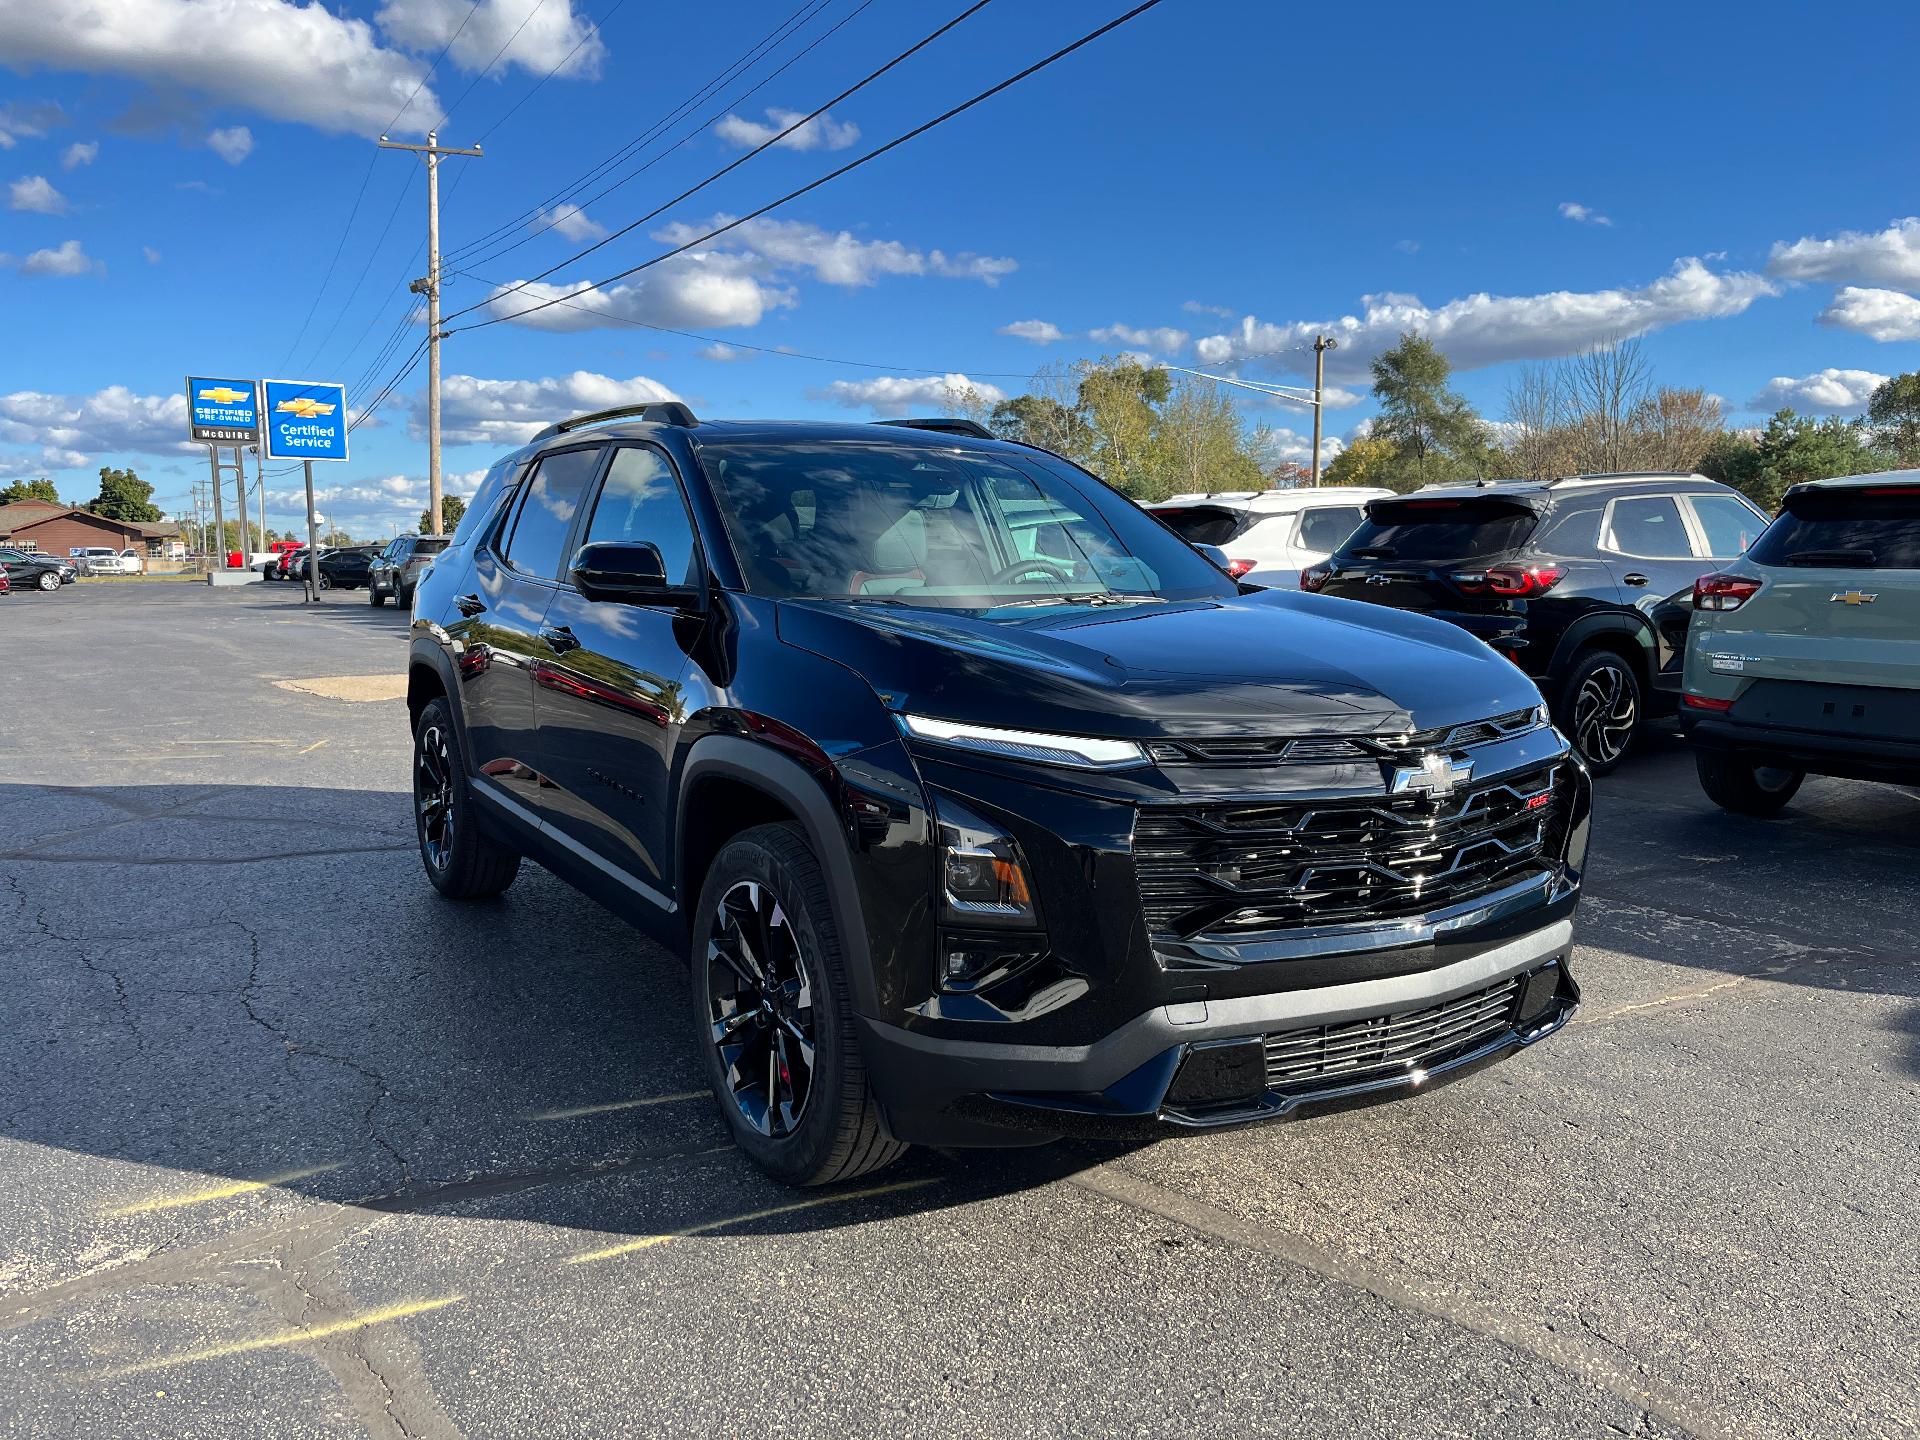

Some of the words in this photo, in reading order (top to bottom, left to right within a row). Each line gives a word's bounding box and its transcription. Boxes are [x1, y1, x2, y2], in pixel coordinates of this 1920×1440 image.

[195, 408, 253, 417] CERTIFIED
[199, 414, 251, 423] PRE-OWNED
[202, 429, 250, 440] McGUIRE
[280, 424, 335, 437] Certified
[285, 436, 332, 448] Service
[1525, 793, 1550, 810] RS
